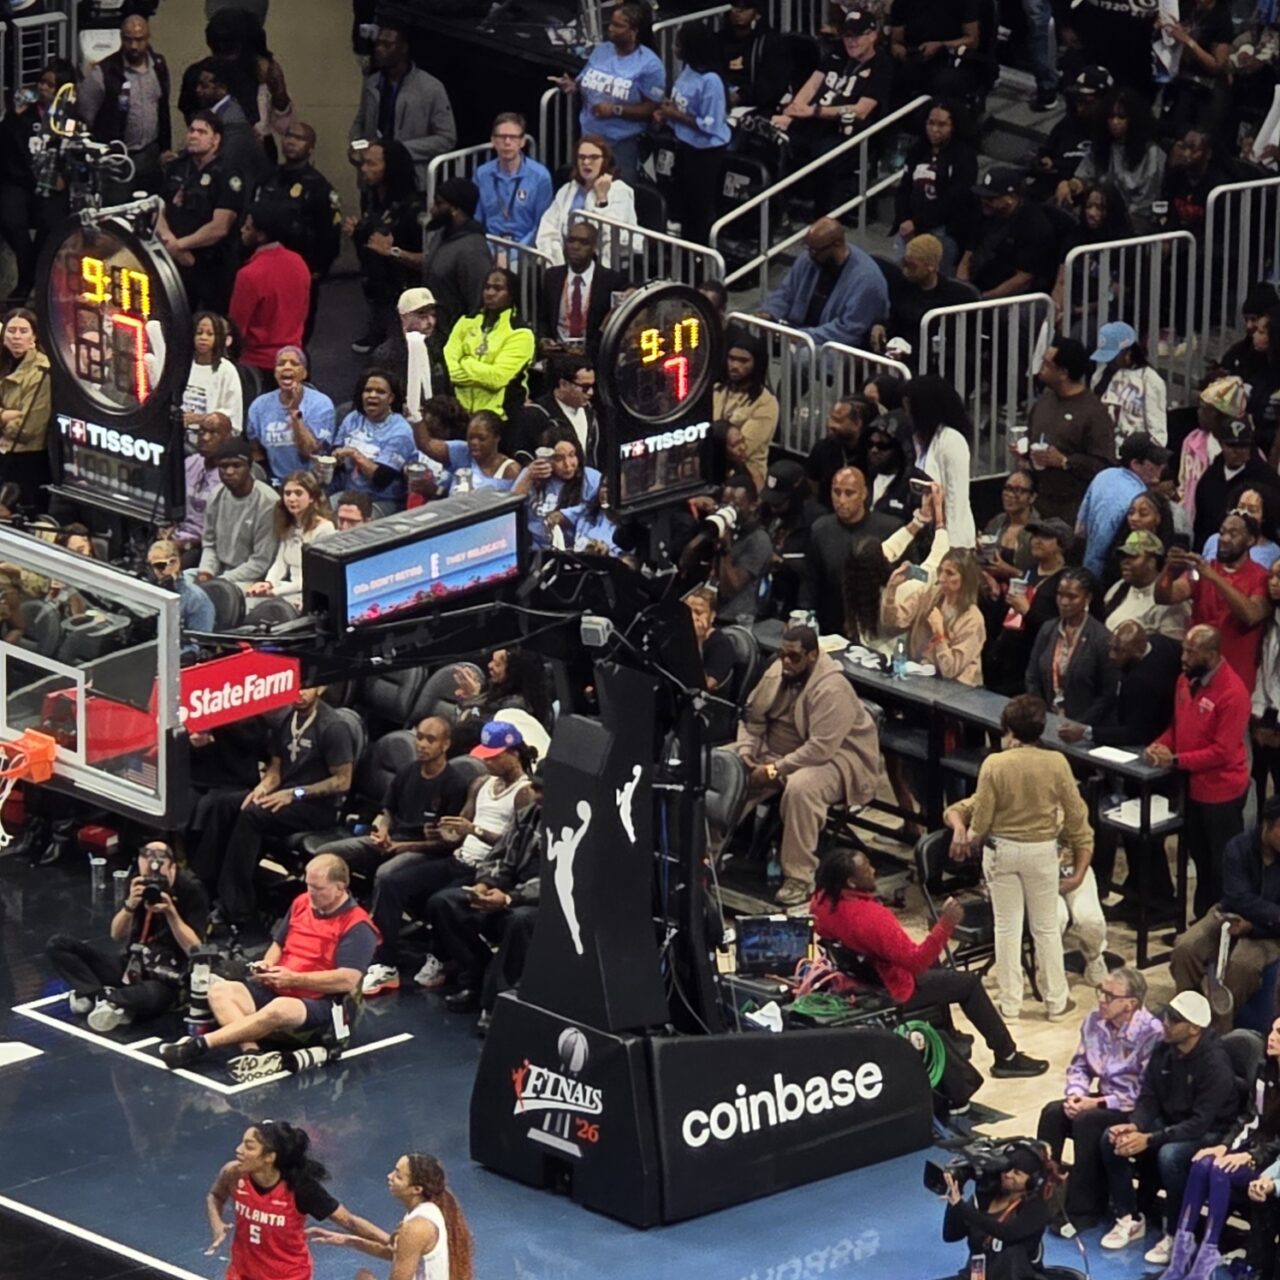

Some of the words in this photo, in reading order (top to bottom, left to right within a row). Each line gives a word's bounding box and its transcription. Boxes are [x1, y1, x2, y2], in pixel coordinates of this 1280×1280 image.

[81, 256, 150, 316] 9:17
[111, 312, 150, 406] 7
[641, 317, 699, 364] 9:17
[664, 356, 688, 401] 7
[86, 422, 165, 466] TISSOT
[645, 421, 710, 453] TISSOT
[521, 1064, 603, 1112] FINALS
[682, 1062, 884, 1148] coinbase
[249, 1224, 261, 1245] 5
